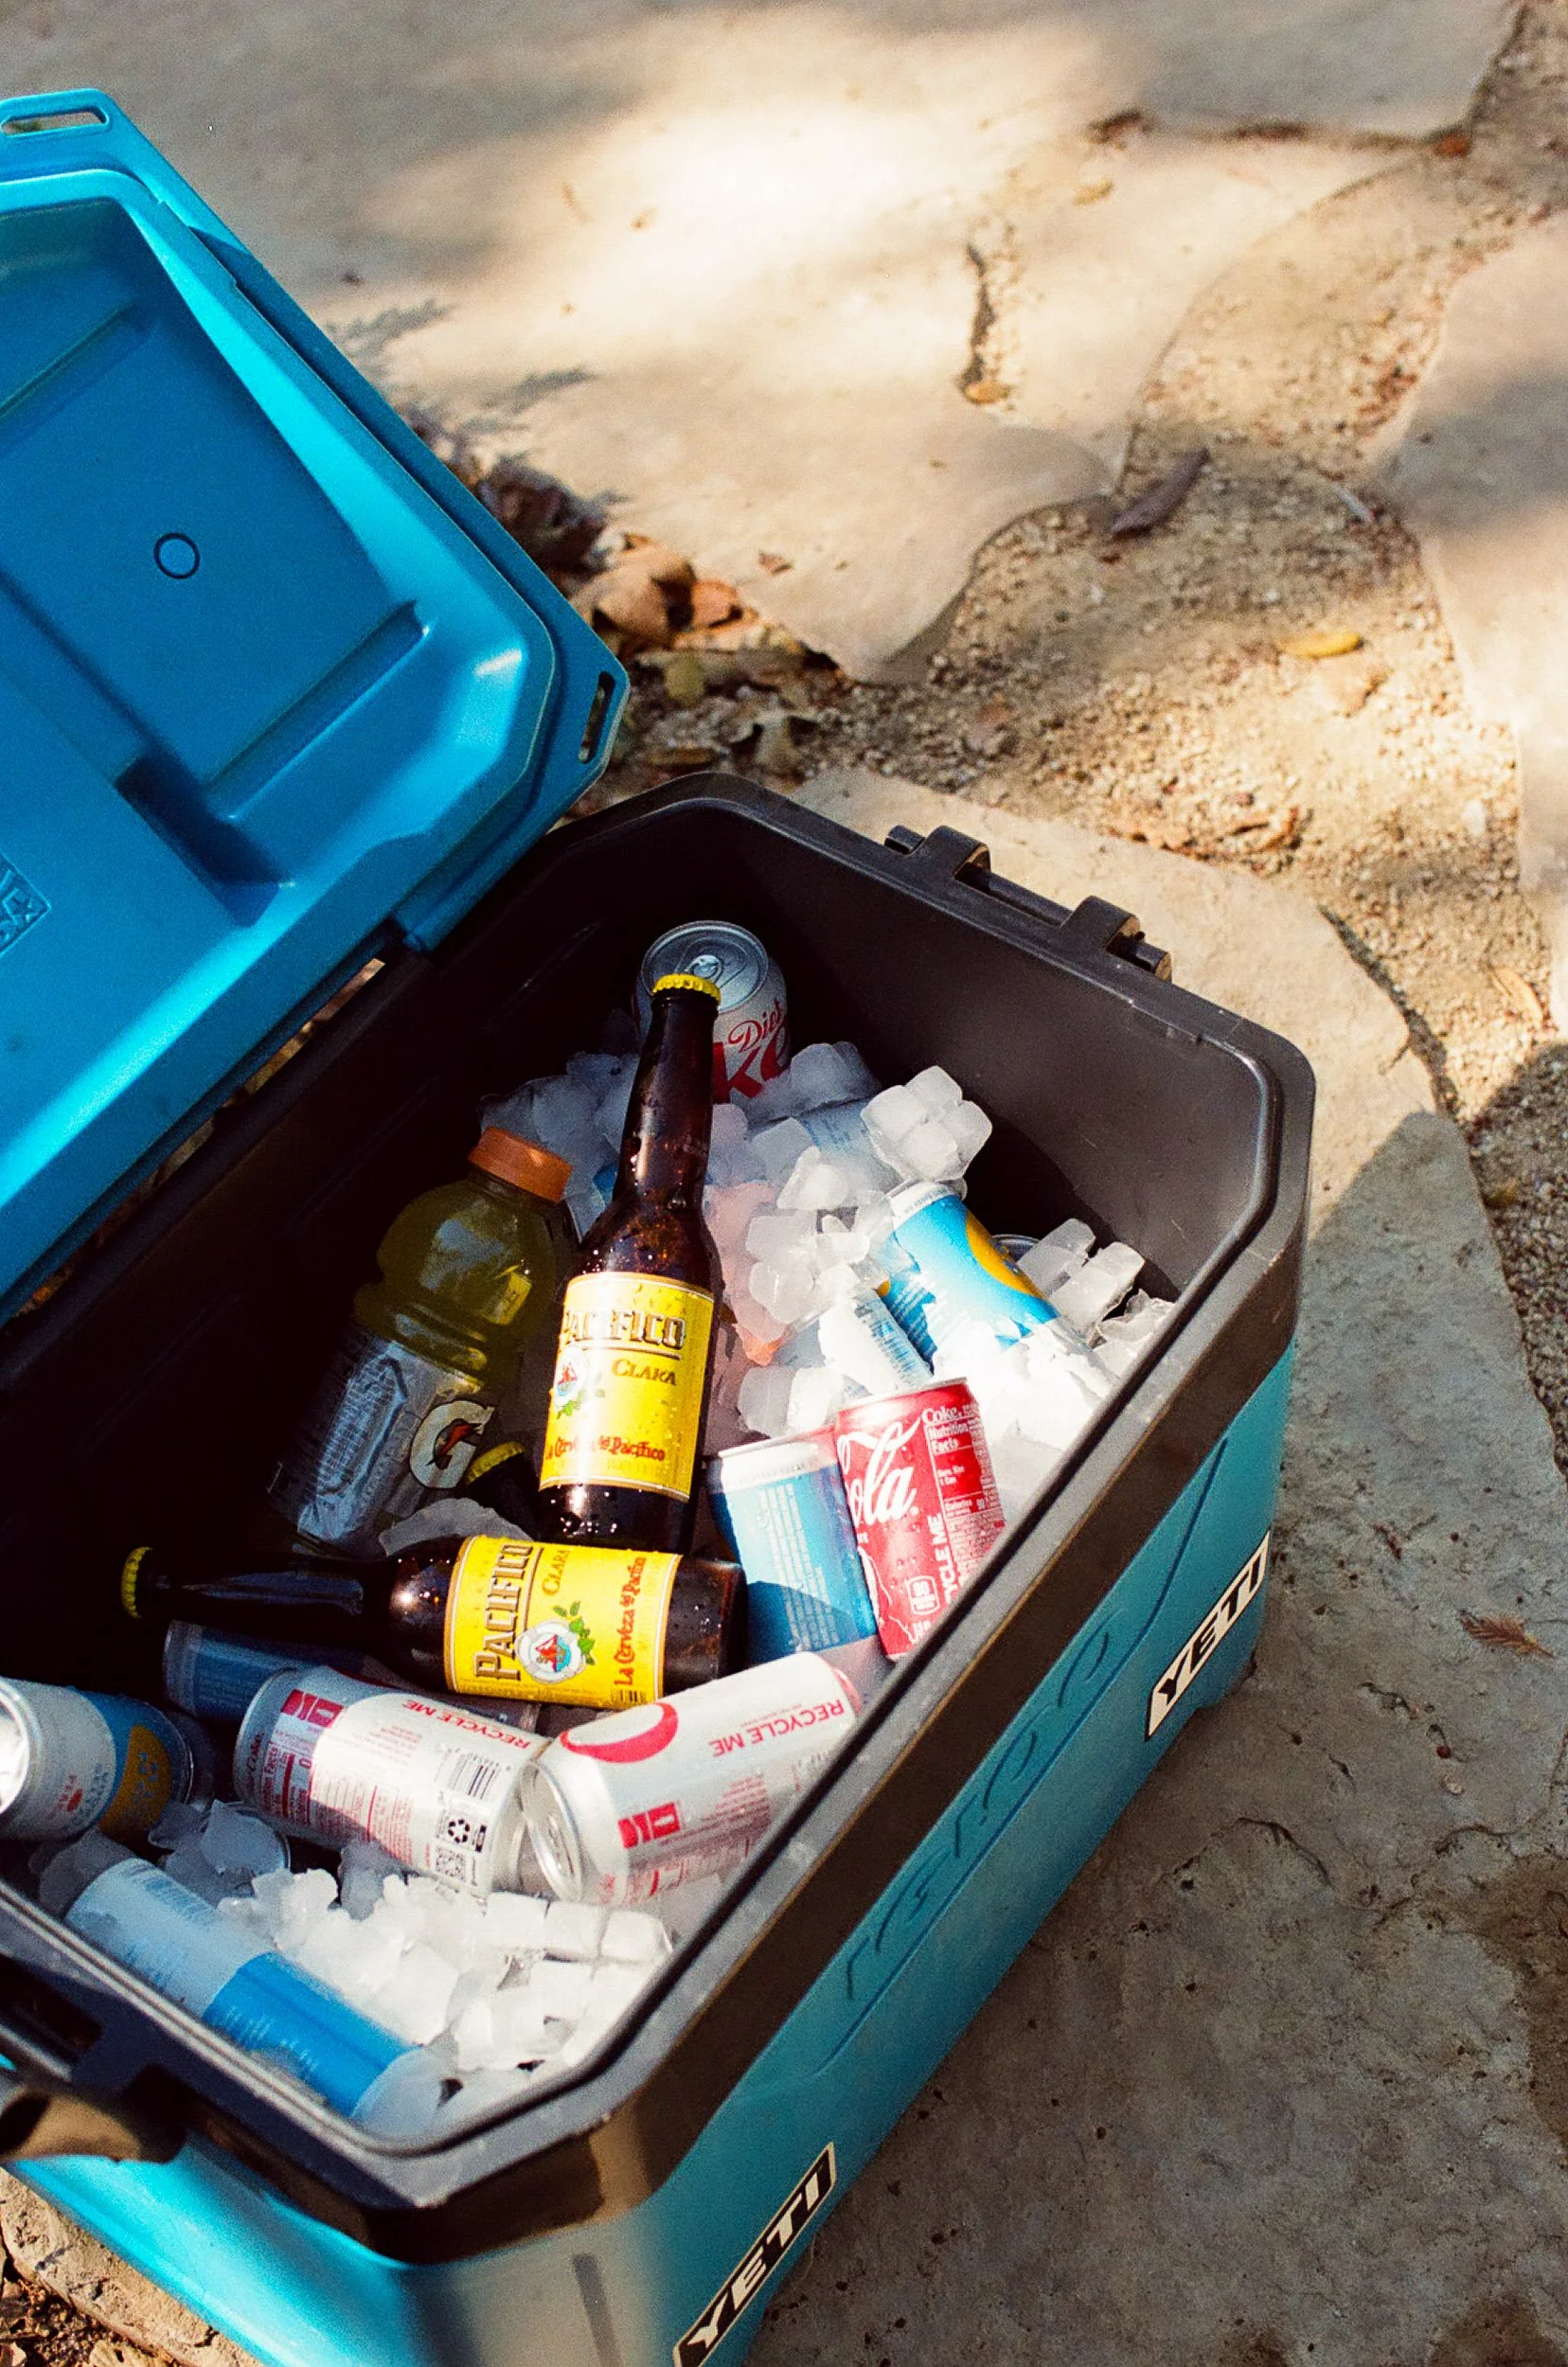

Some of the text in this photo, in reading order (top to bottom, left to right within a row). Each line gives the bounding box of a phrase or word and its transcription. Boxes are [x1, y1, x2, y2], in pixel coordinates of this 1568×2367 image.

[727, 998, 784, 1053] Diet
[561, 1308, 686, 1350] ACFICO
[612, 1358, 677, 1386] CLARA
[410, 1399, 496, 1489] G
[926, 1513, 948, 1545] ME
[541, 1546, 571, 1596] CLARA
[934, 1545, 959, 1605] YCLE
[473, 1542, 534, 1682] PACIFICO
[1157, 1551, 1263, 1706] YETI
[402, 1700, 437, 1717] ME
[437, 1712, 531, 1749] RECYCLE
[745, 1700, 845, 1744] RECYCLE
[707, 1732, 745, 1757] ME
[686, 2170, 821, 2349] YETI
